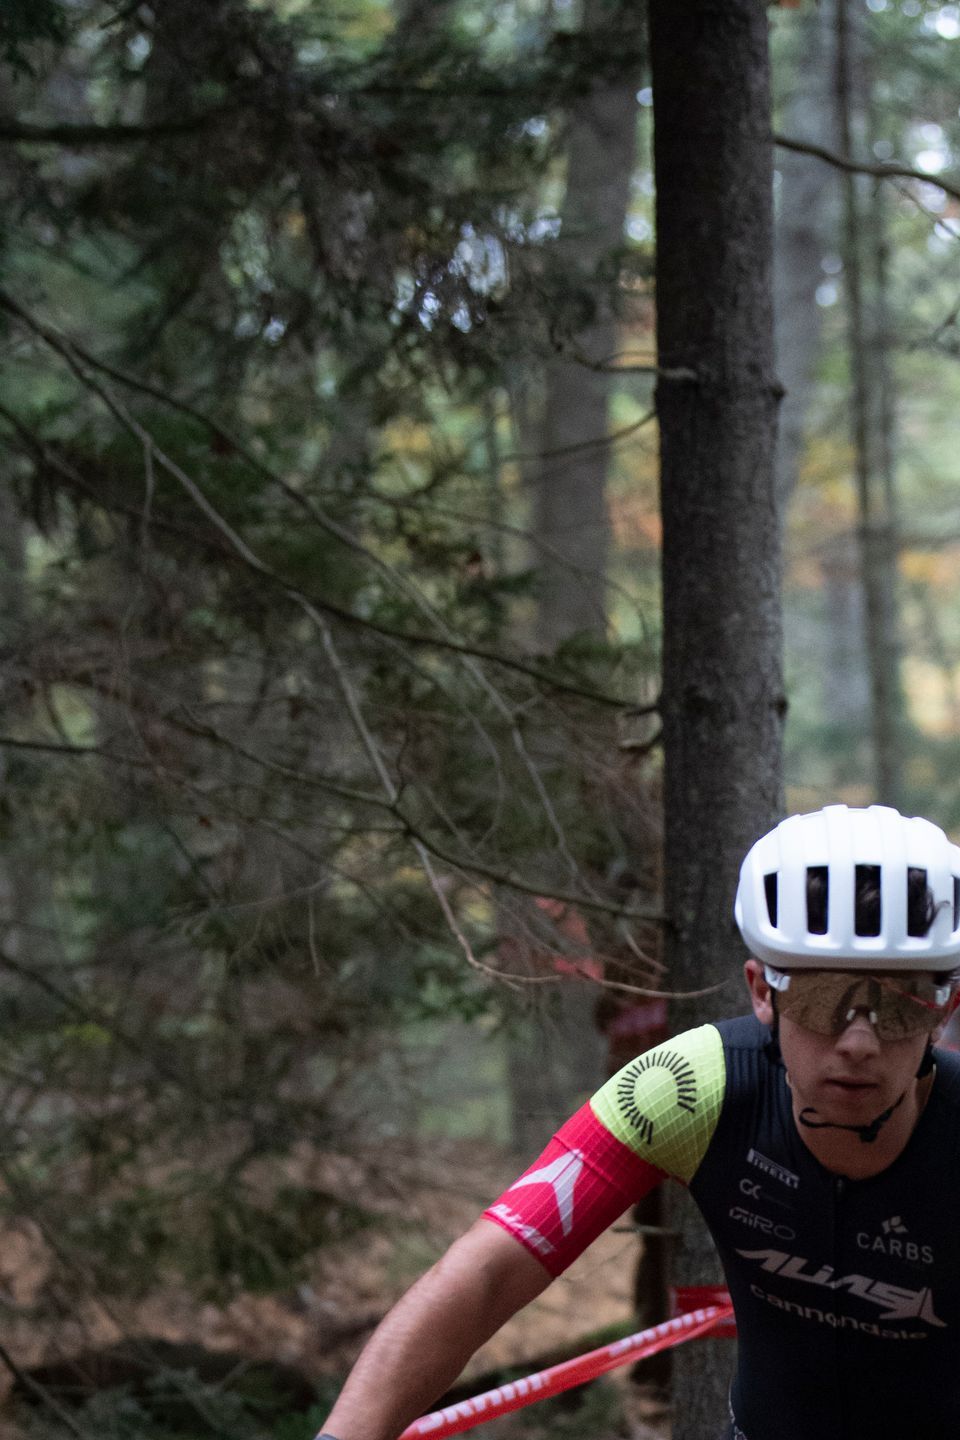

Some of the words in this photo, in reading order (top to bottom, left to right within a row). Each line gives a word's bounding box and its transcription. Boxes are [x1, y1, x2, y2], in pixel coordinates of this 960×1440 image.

[746, 1148, 800, 1190] PIRELLI
[856, 1232, 935, 1264] CARBS
[749, 1283, 929, 1341] cannondale
[417, 1373, 544, 1434] SRAM
